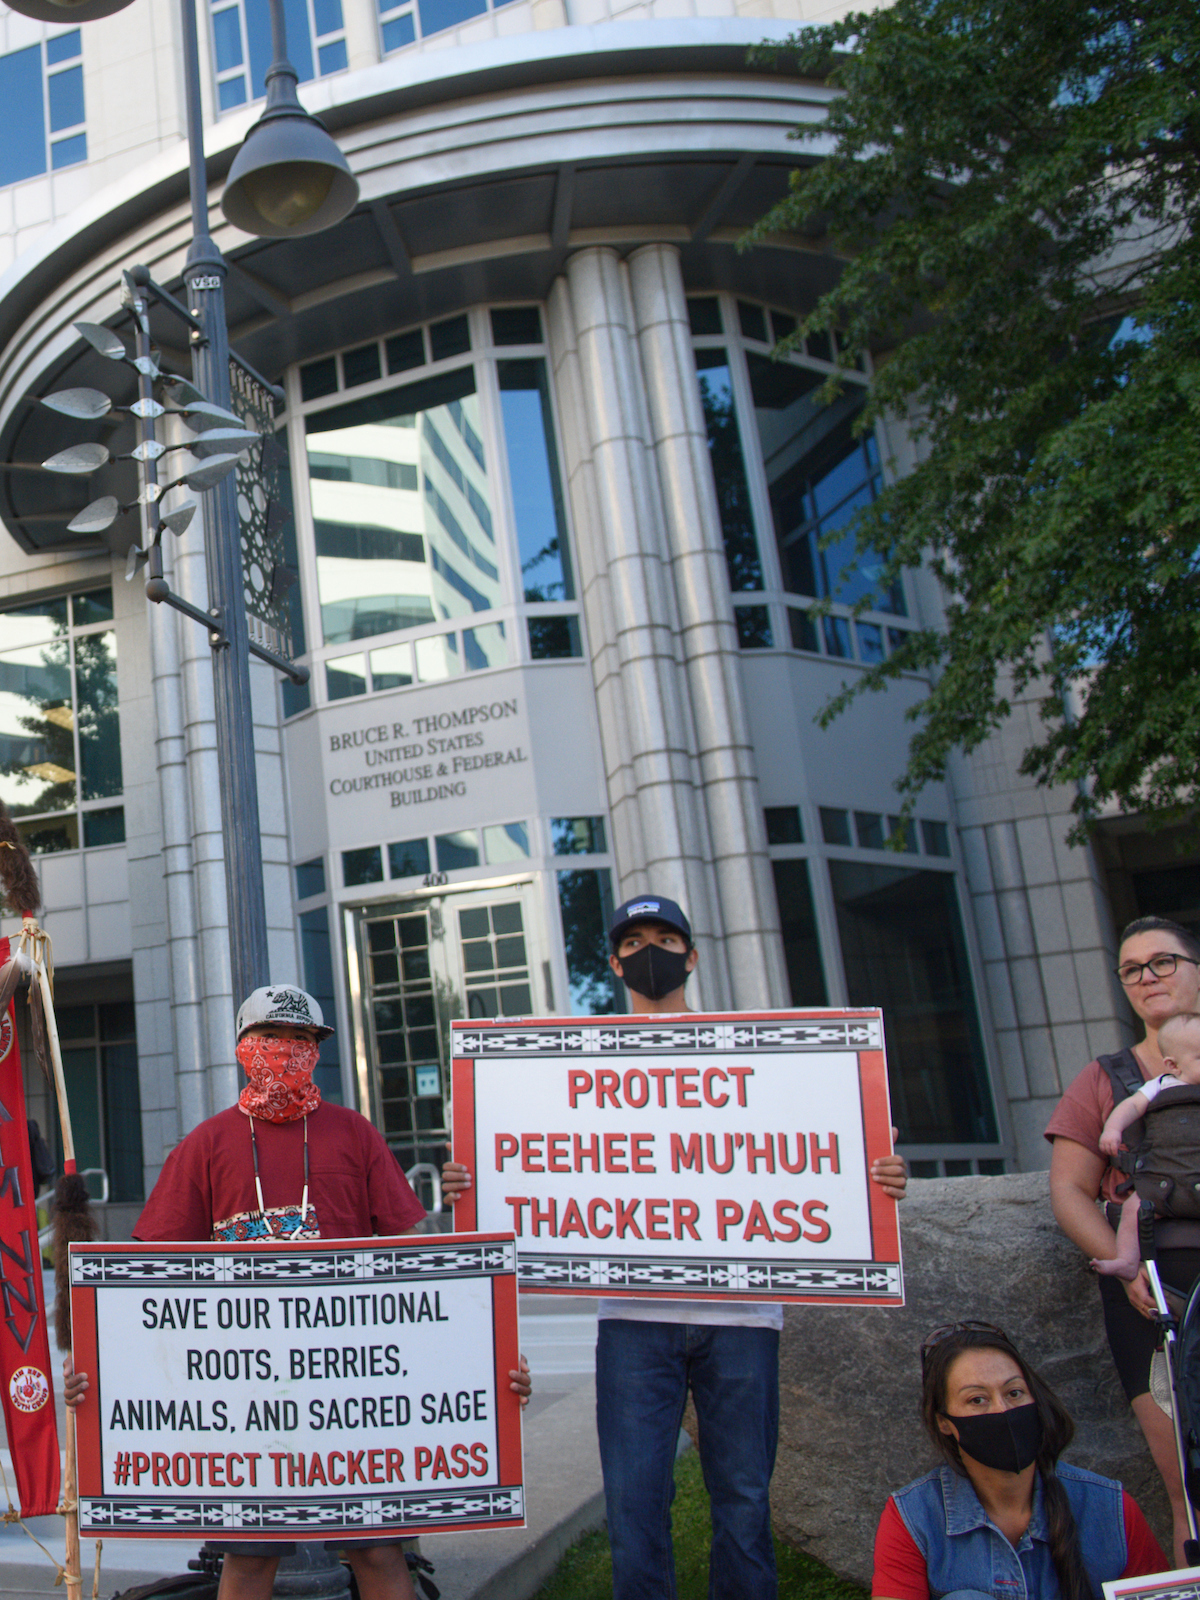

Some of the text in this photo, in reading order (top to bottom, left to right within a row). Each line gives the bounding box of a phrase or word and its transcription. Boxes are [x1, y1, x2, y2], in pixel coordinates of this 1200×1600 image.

[194, 277, 219, 287] VS6
[330, 699, 518, 751] BRUCE R. THOMPSON
[365, 732, 484, 767] UNITED STATES
[330, 747, 527, 796] COURTHOUSE & FEDERAL
[390, 781, 467, 808] BUILDING
[422, 871, 448, 888] 400
[568, 1067, 754, 1109] PROTECT
[494, 1131, 841, 1175] PEEHEE MU'HUH
[504, 1196, 832, 1243] THACKER PASS
[142, 1290, 449, 1330] SAVE OUR TRADITIONAL
[187, 1344, 408, 1383] ROOTS, BERRIES,
[110, 1390, 488, 1434] ANIMALS, AND SACRED SAGE
[113, 1442, 488, 1487] #PROTECT THACKER PASS
